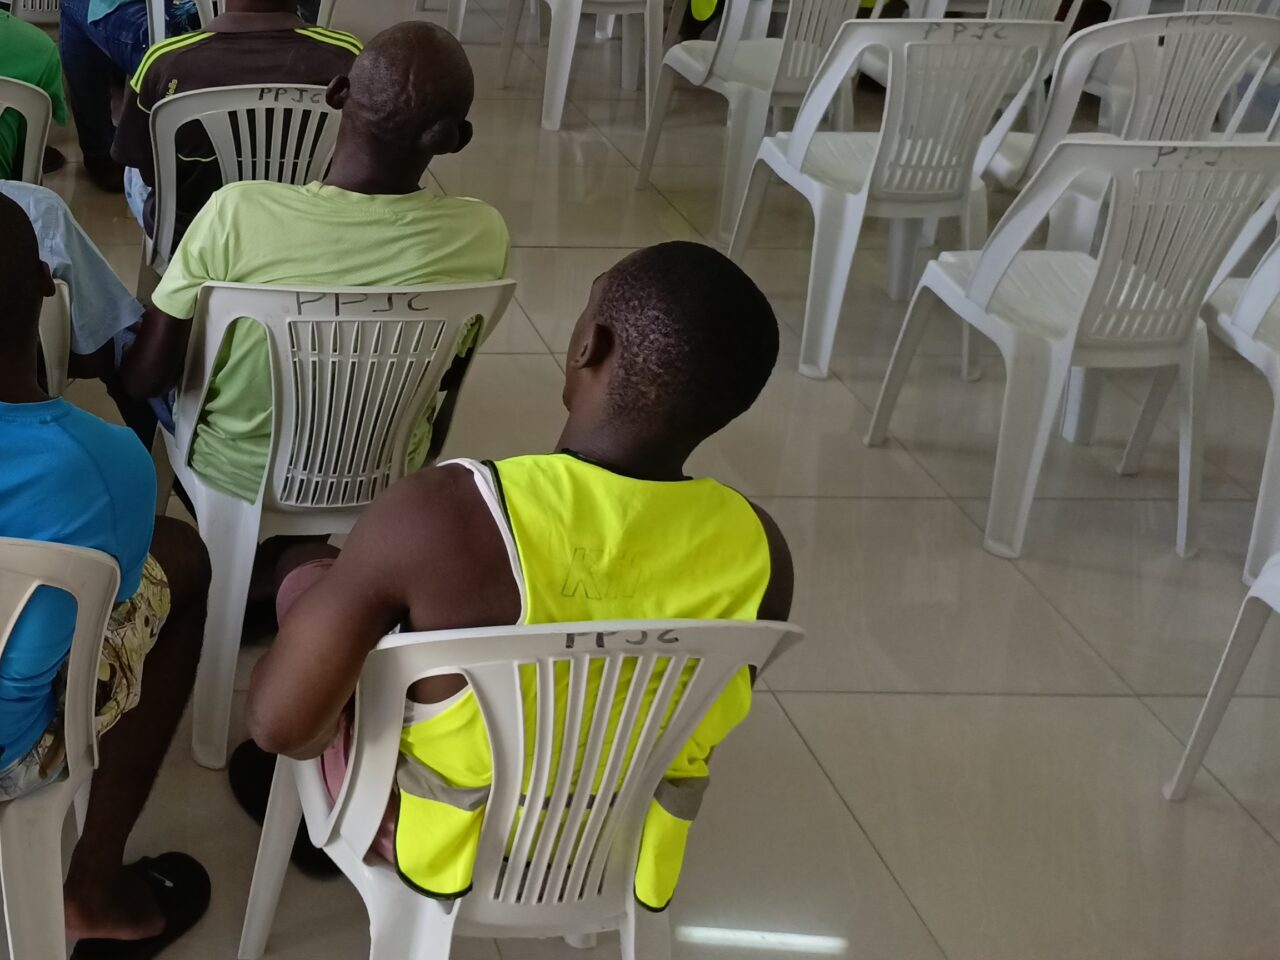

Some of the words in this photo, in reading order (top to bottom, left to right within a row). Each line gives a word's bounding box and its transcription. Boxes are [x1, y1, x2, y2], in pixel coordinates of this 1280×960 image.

[258, 87, 321, 103] PPJC
[296, 291, 429, 316] PPJC
[565, 628, 680, 649] PPJC
